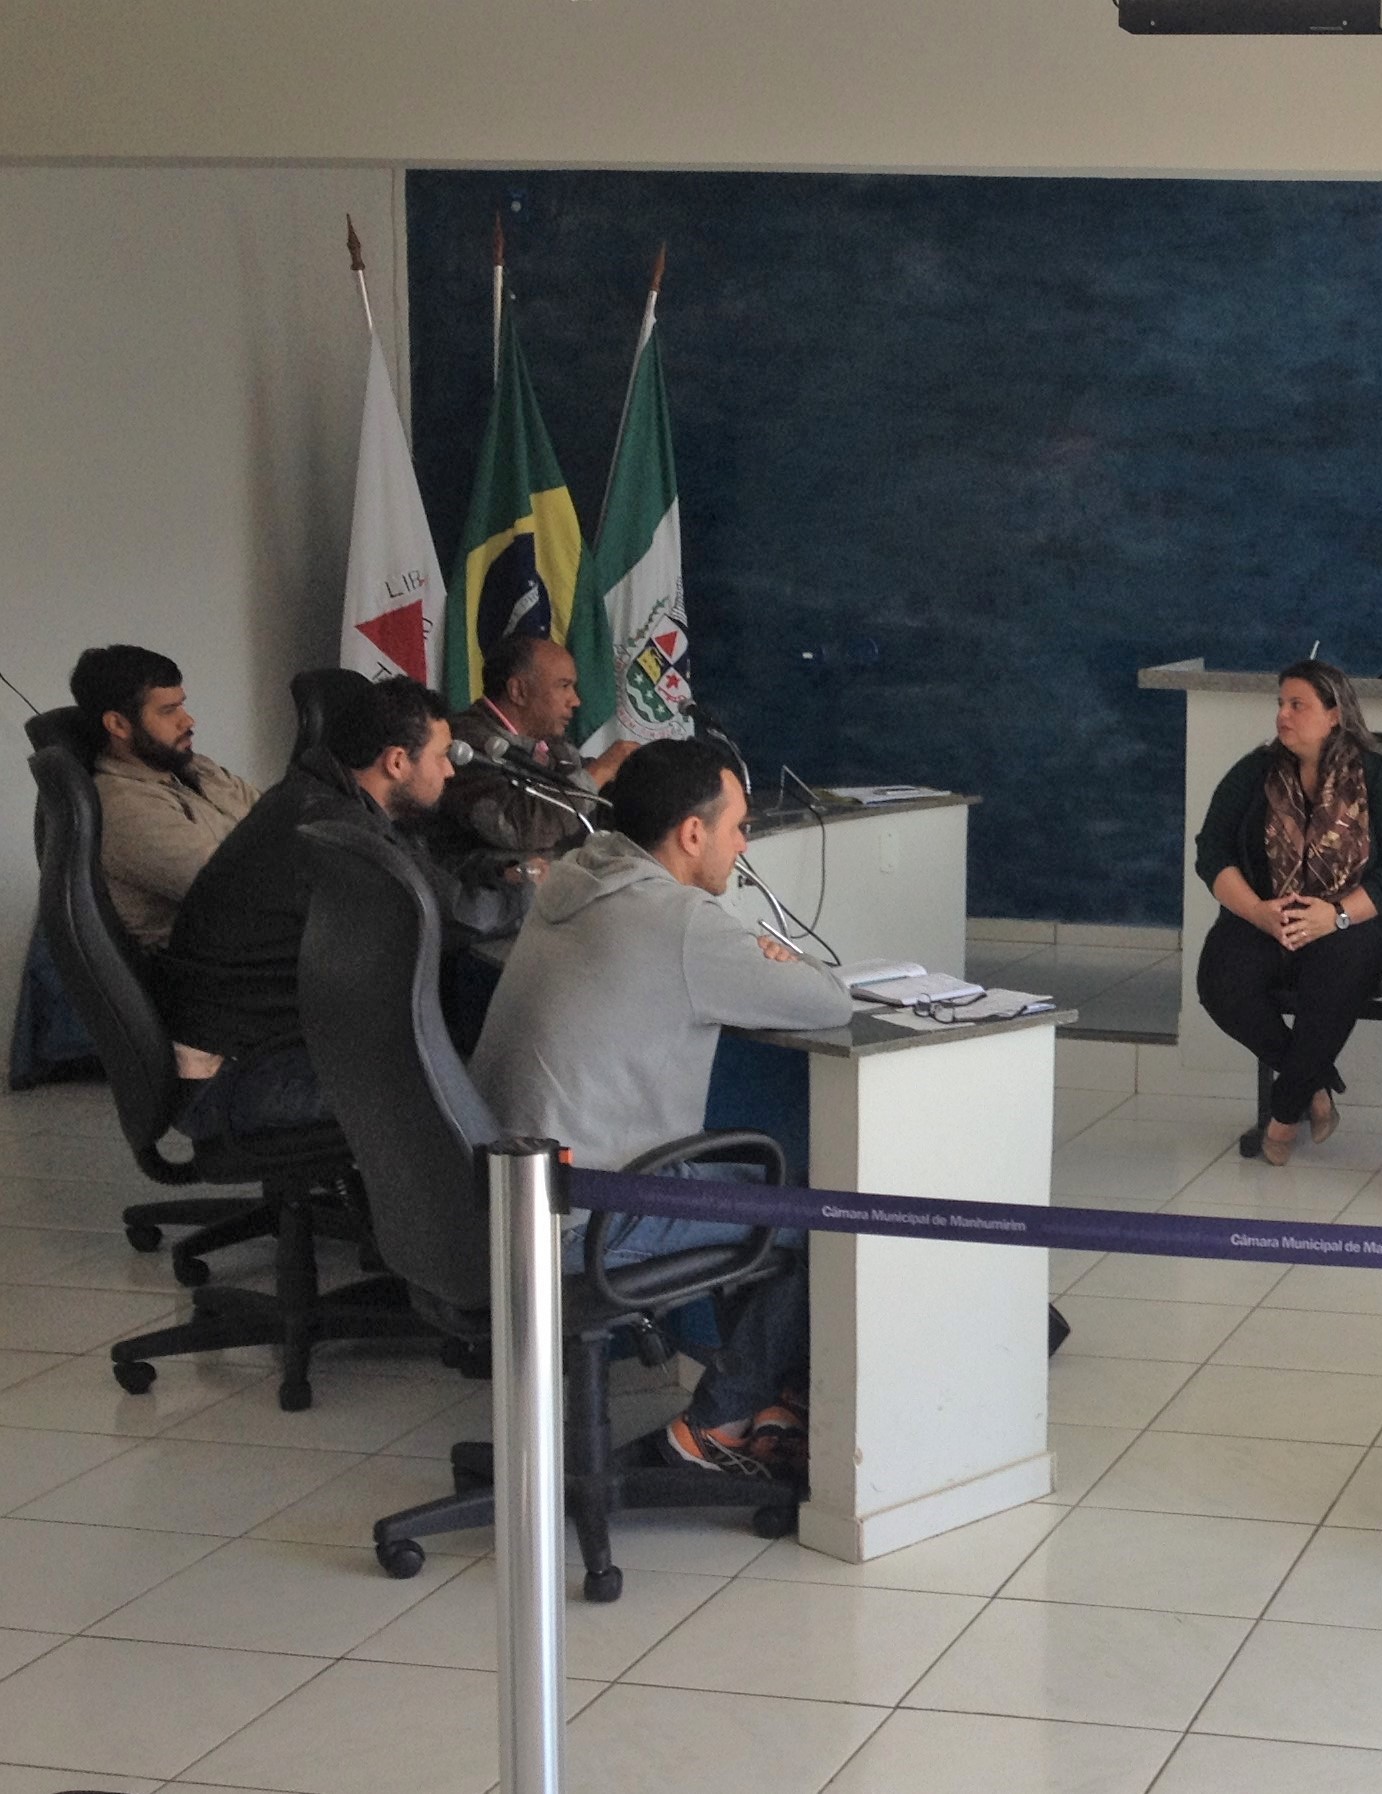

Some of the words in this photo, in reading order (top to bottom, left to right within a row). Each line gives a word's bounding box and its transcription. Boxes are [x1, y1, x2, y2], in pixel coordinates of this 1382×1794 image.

[821, 1205, 869, 1220] Câmara
[871, 1209, 930, 1226] Municipal
[931, 1214, 947, 1226] de
[950, 1215, 1026, 1231] Manhumirim
[1230, 1233, 1280, 1248] Câmara
[1281, 1236, 1343, 1254] Municipal
[1344, 1240, 1361, 1253] de
